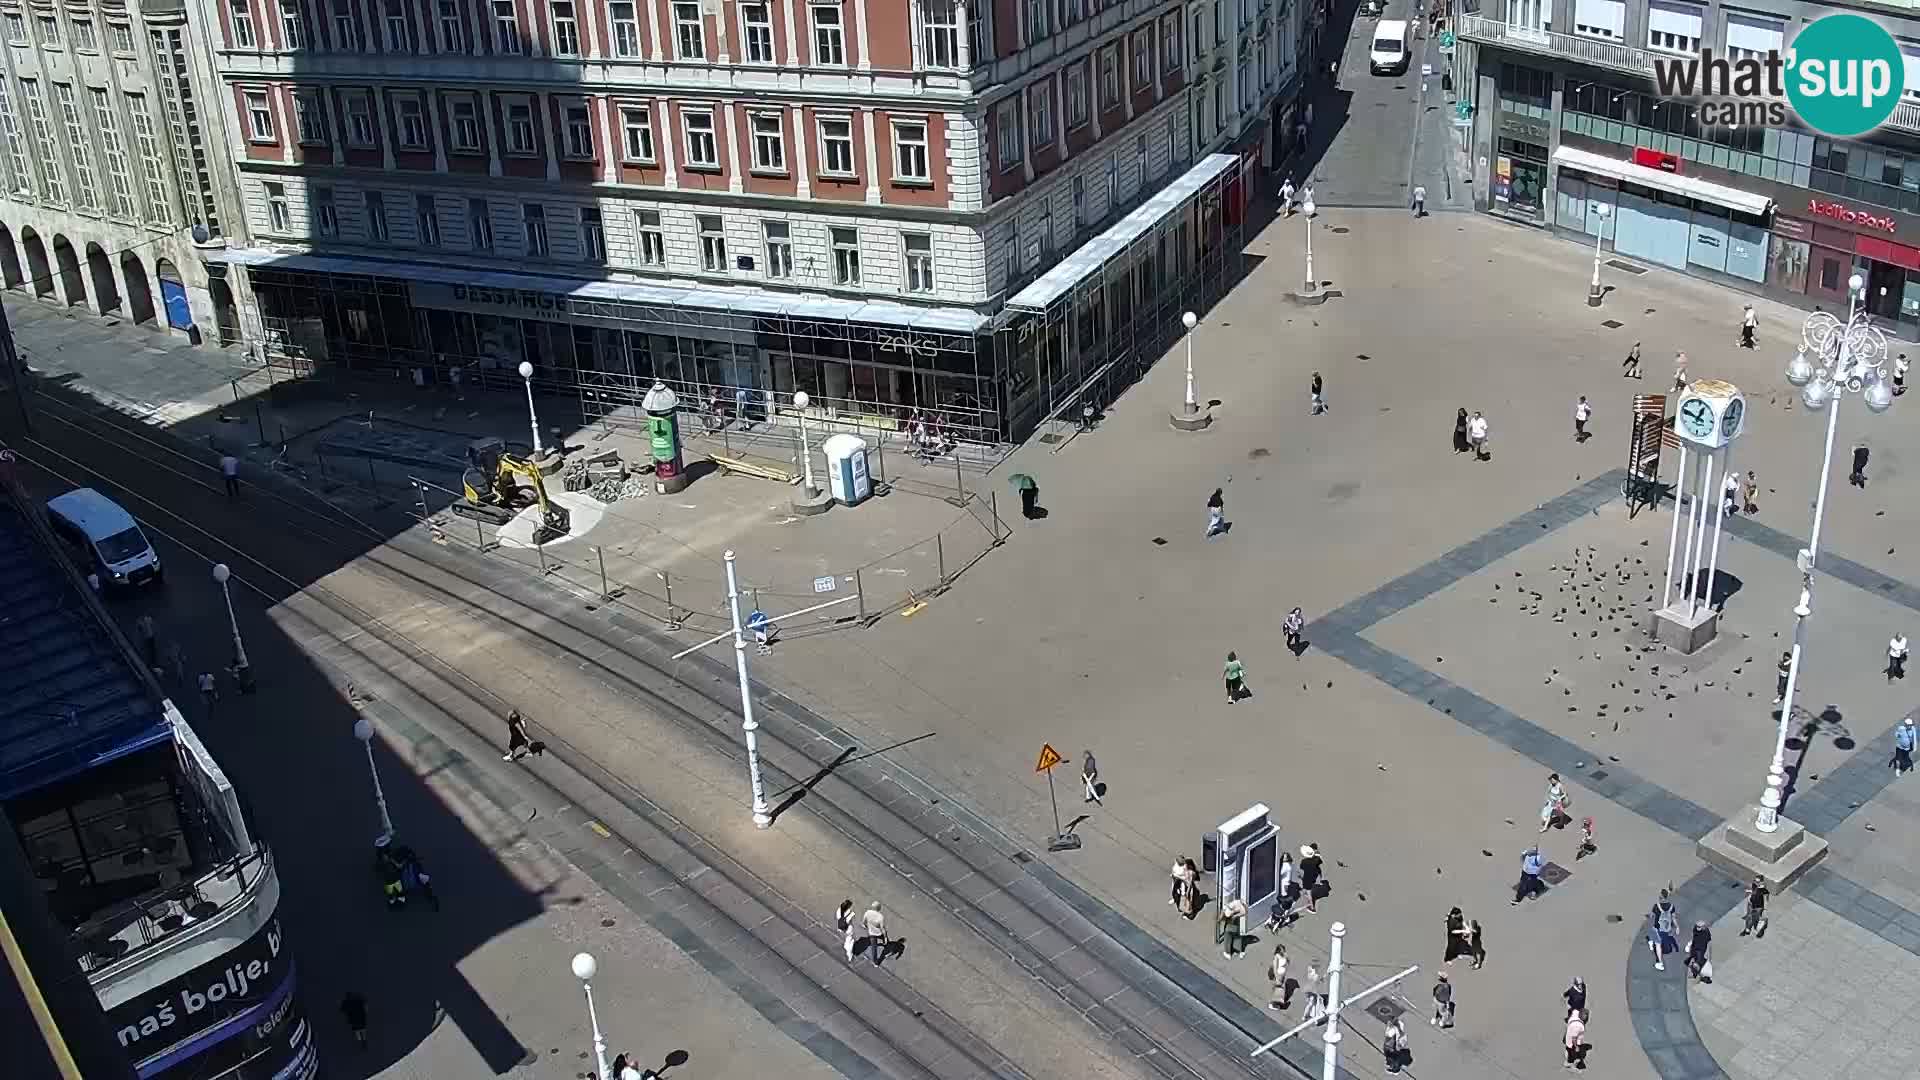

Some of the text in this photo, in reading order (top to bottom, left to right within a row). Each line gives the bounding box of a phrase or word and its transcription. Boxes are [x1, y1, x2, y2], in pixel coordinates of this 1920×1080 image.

[1808, 199, 1896, 233] Addiko Bank
[116, 999, 176, 1047] naš
[180, 958, 269, 1014] bolje,
